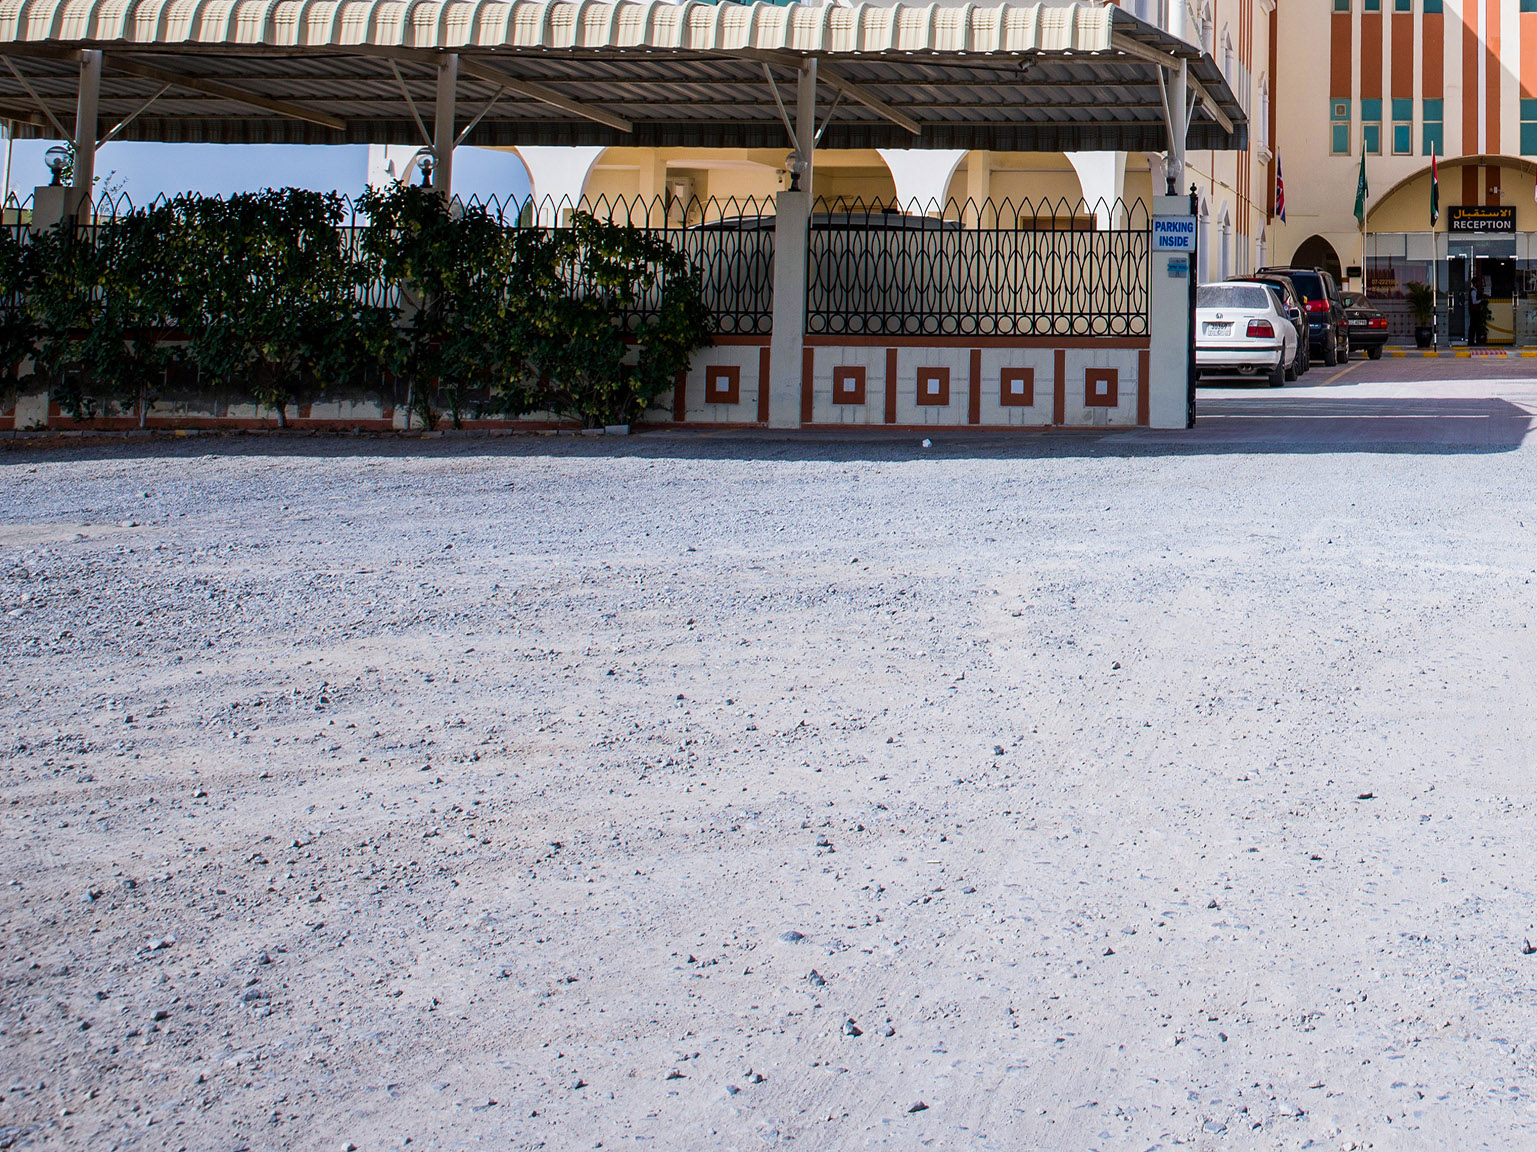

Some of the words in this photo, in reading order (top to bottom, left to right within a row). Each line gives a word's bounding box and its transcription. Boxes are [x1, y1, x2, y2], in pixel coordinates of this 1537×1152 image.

[1453, 209, 1512, 219] الاستقبال
[1155, 221, 1194, 233] PARKING
[1453, 220, 1511, 229] RECEPTION
[1159, 236, 1189, 247] INSIDE
